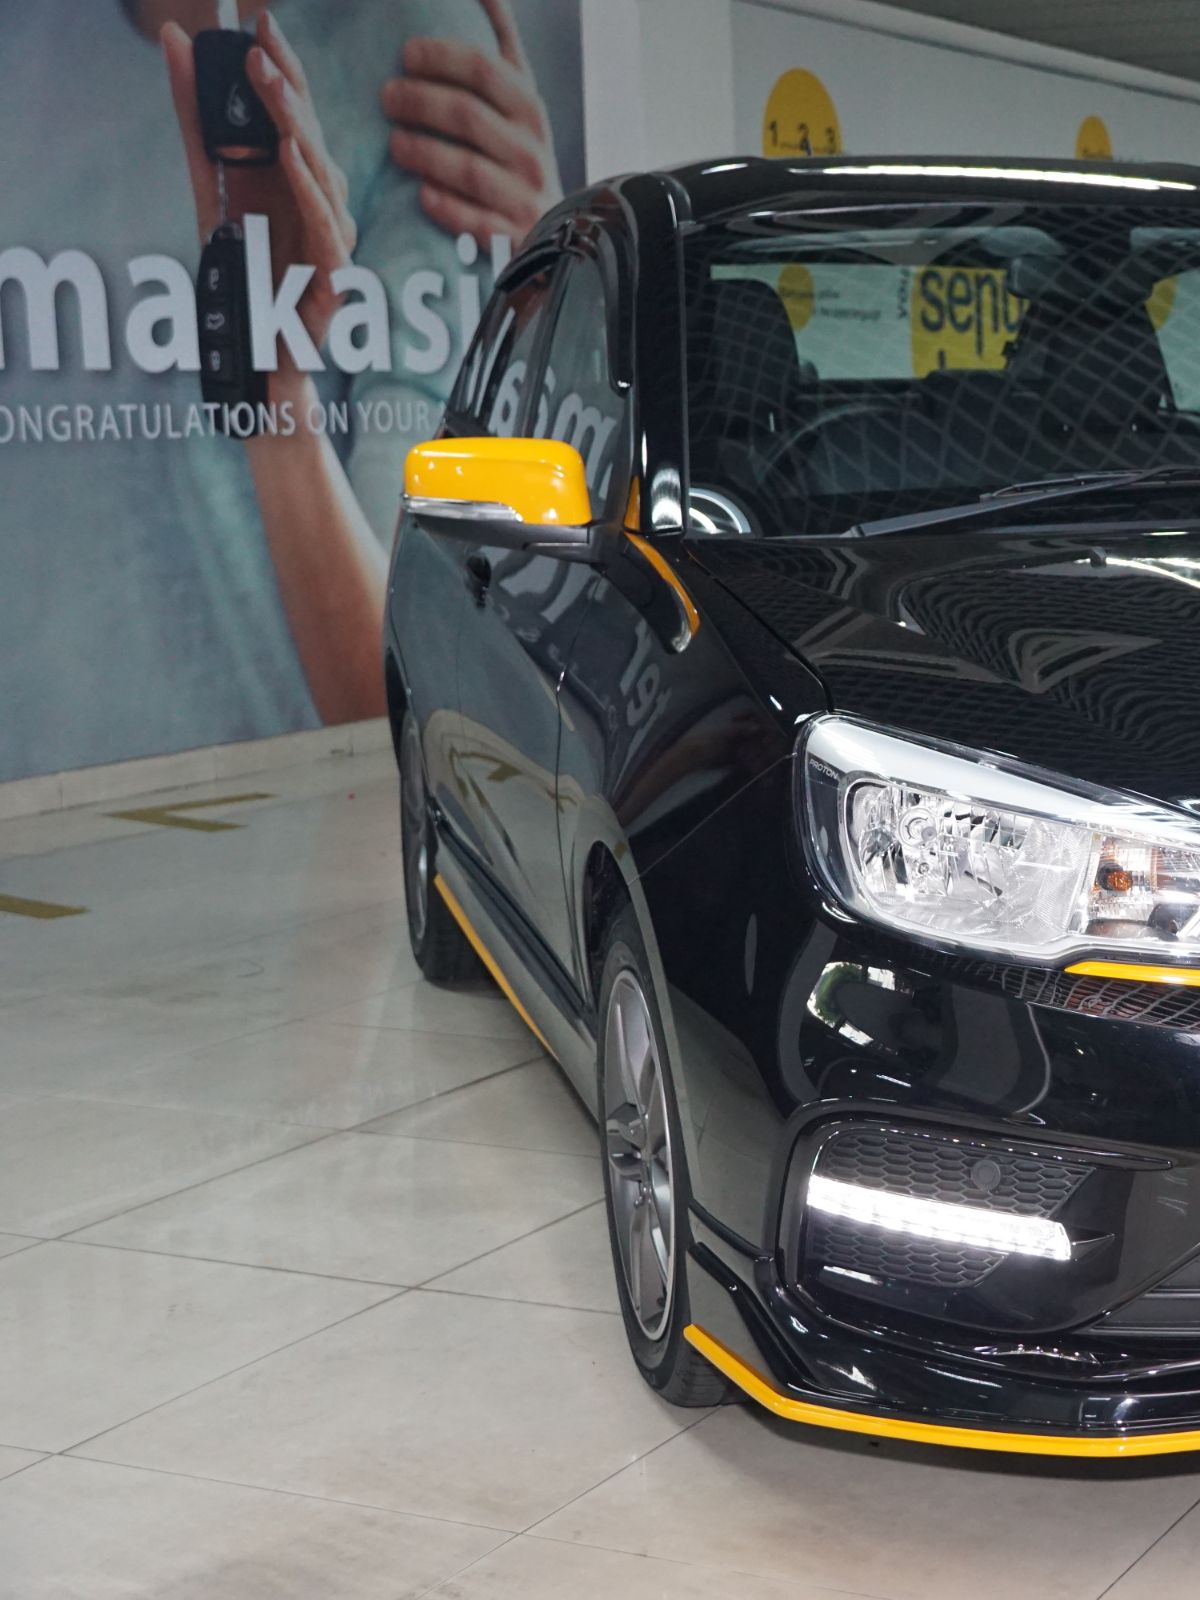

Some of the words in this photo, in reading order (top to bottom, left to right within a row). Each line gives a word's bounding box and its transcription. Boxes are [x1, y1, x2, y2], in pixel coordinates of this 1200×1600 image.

[307, 401, 349, 435] ON
[356, 400, 431, 433] YOUR
[809, 758, 839, 780] PROTON
